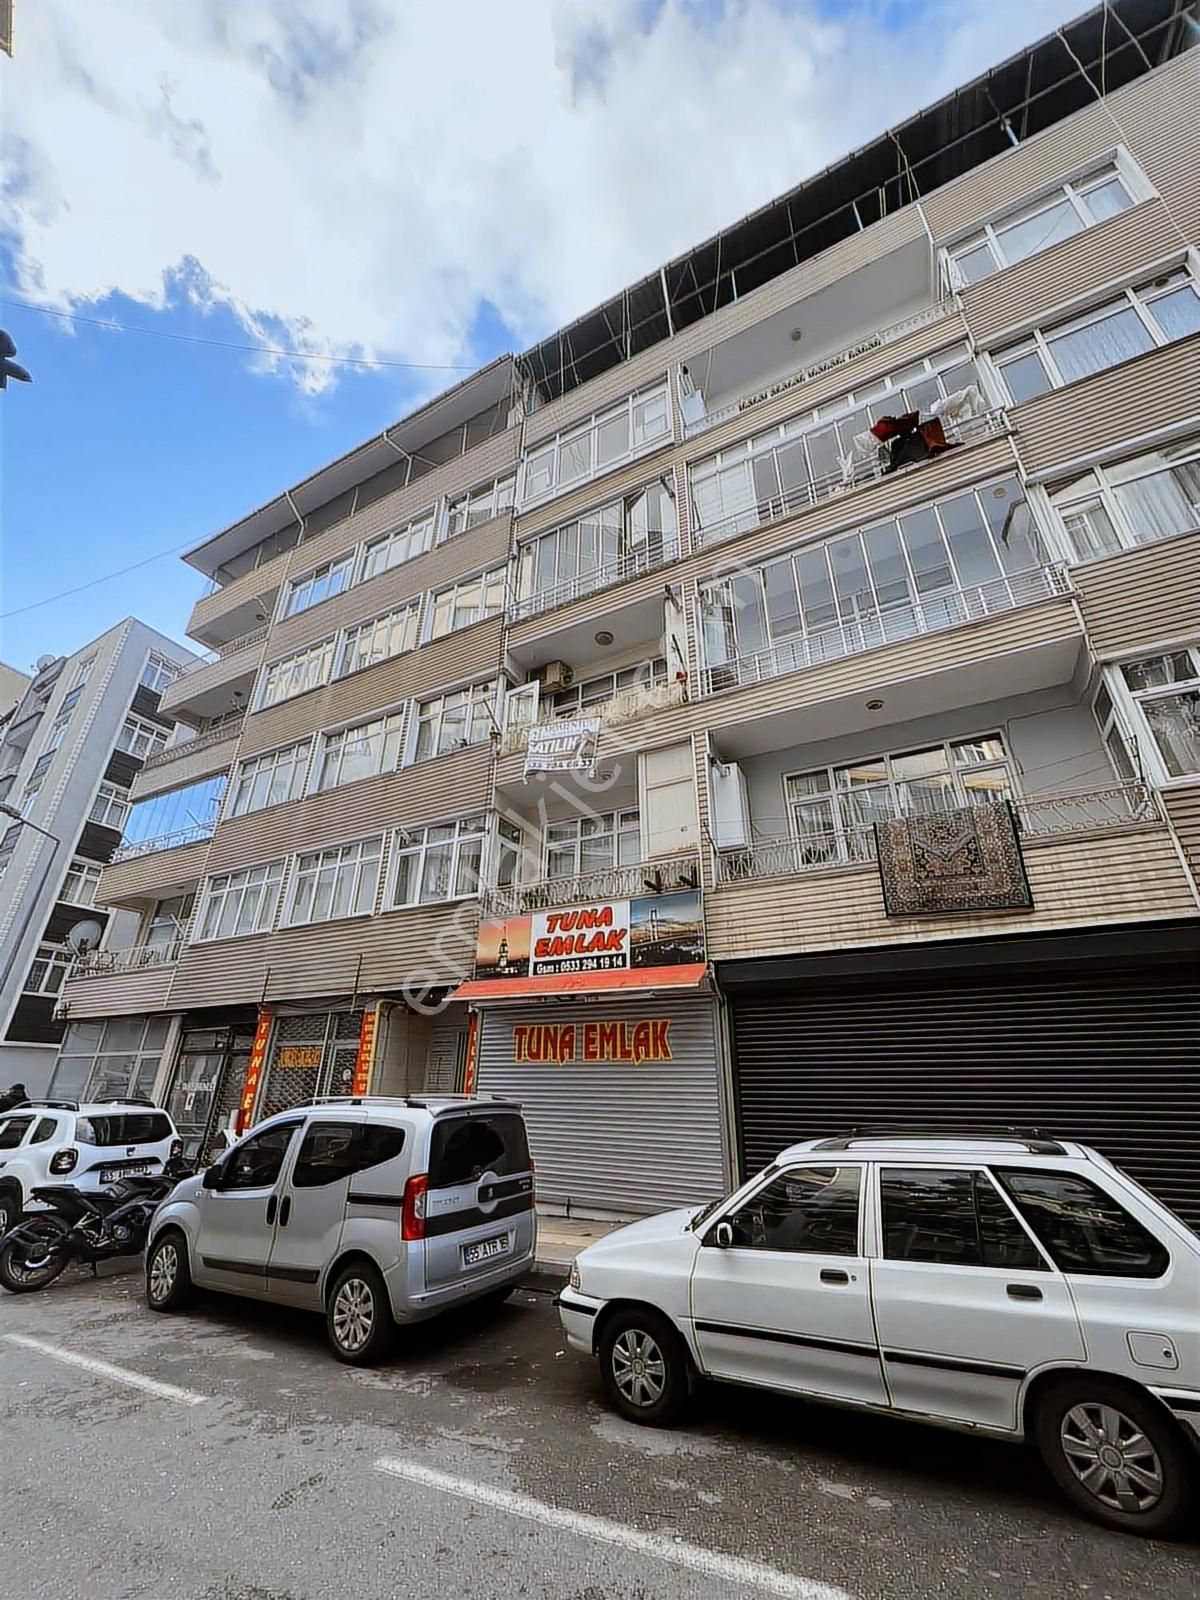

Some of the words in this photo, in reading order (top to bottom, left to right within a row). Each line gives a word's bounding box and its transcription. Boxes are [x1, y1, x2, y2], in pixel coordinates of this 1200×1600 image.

[547, 906, 613, 934] TUNA
[535, 928, 628, 958] EMLAK
[536, 963, 554, 974] Gsm
[560, 960, 580, 972] 0533
[582, 958, 597, 970] 294
[600, 957, 610, 968] 19
[613, 955, 623, 967] 14
[513, 1024, 577, 1067] TUNA
[583, 1019, 673, 1067] EMLAK
